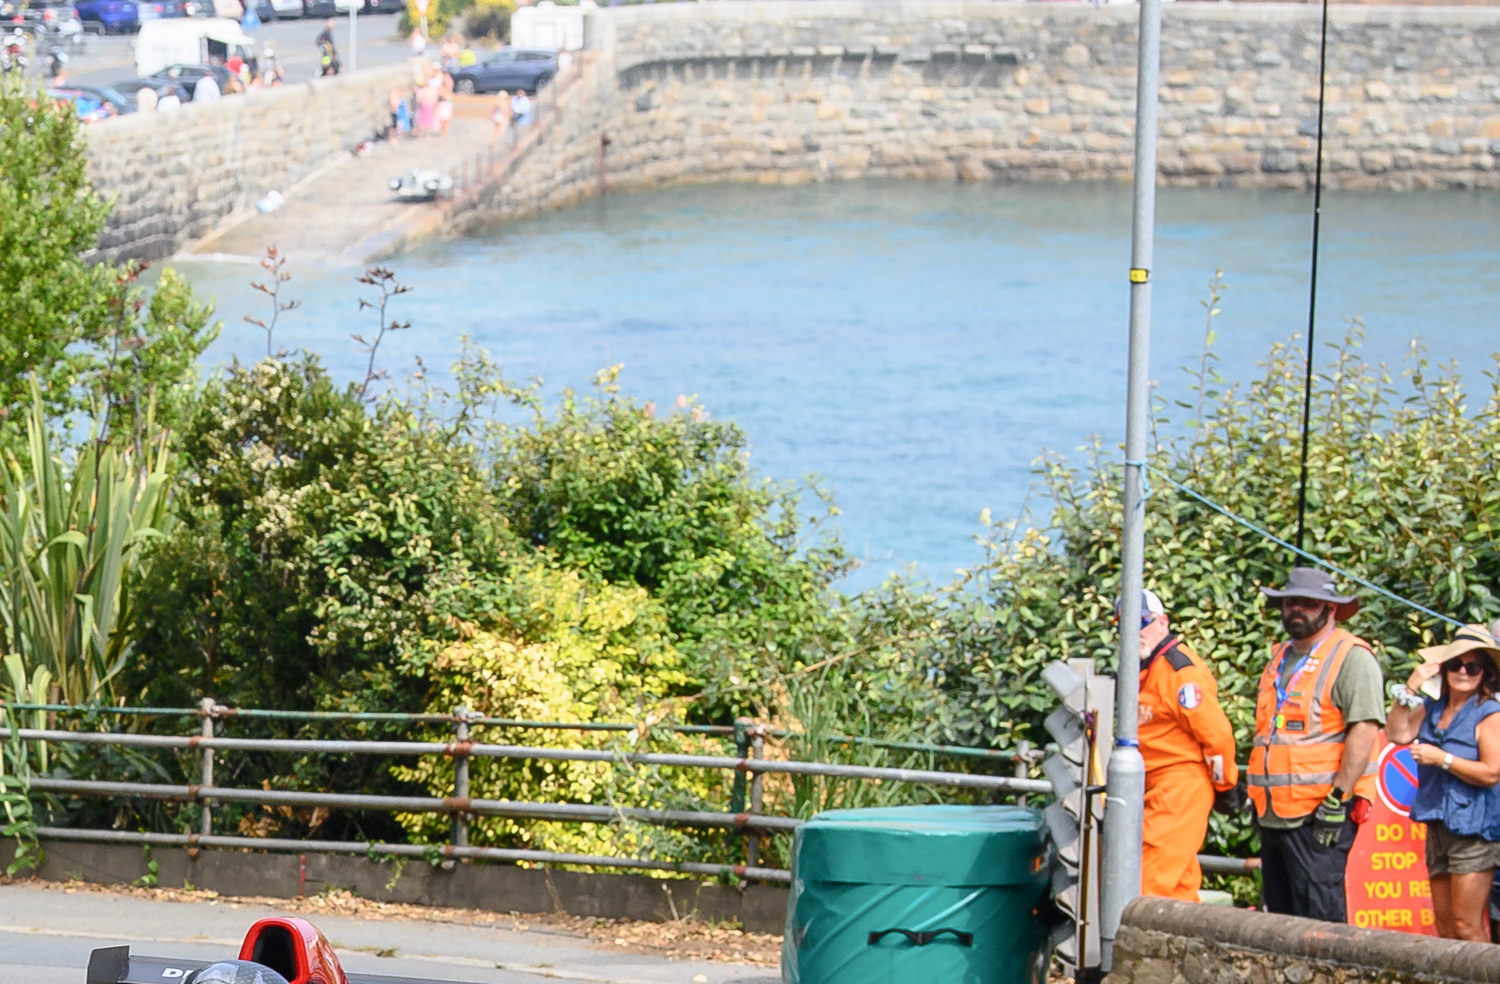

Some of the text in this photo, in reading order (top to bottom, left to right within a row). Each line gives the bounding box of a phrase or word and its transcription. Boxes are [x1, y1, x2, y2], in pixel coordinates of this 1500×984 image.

[1376, 823, 1428, 842] DO N
[1370, 852, 1418, 870] STOP
[1364, 881, 1432, 899] YOU RE
[1354, 909, 1413, 928] OTHER
